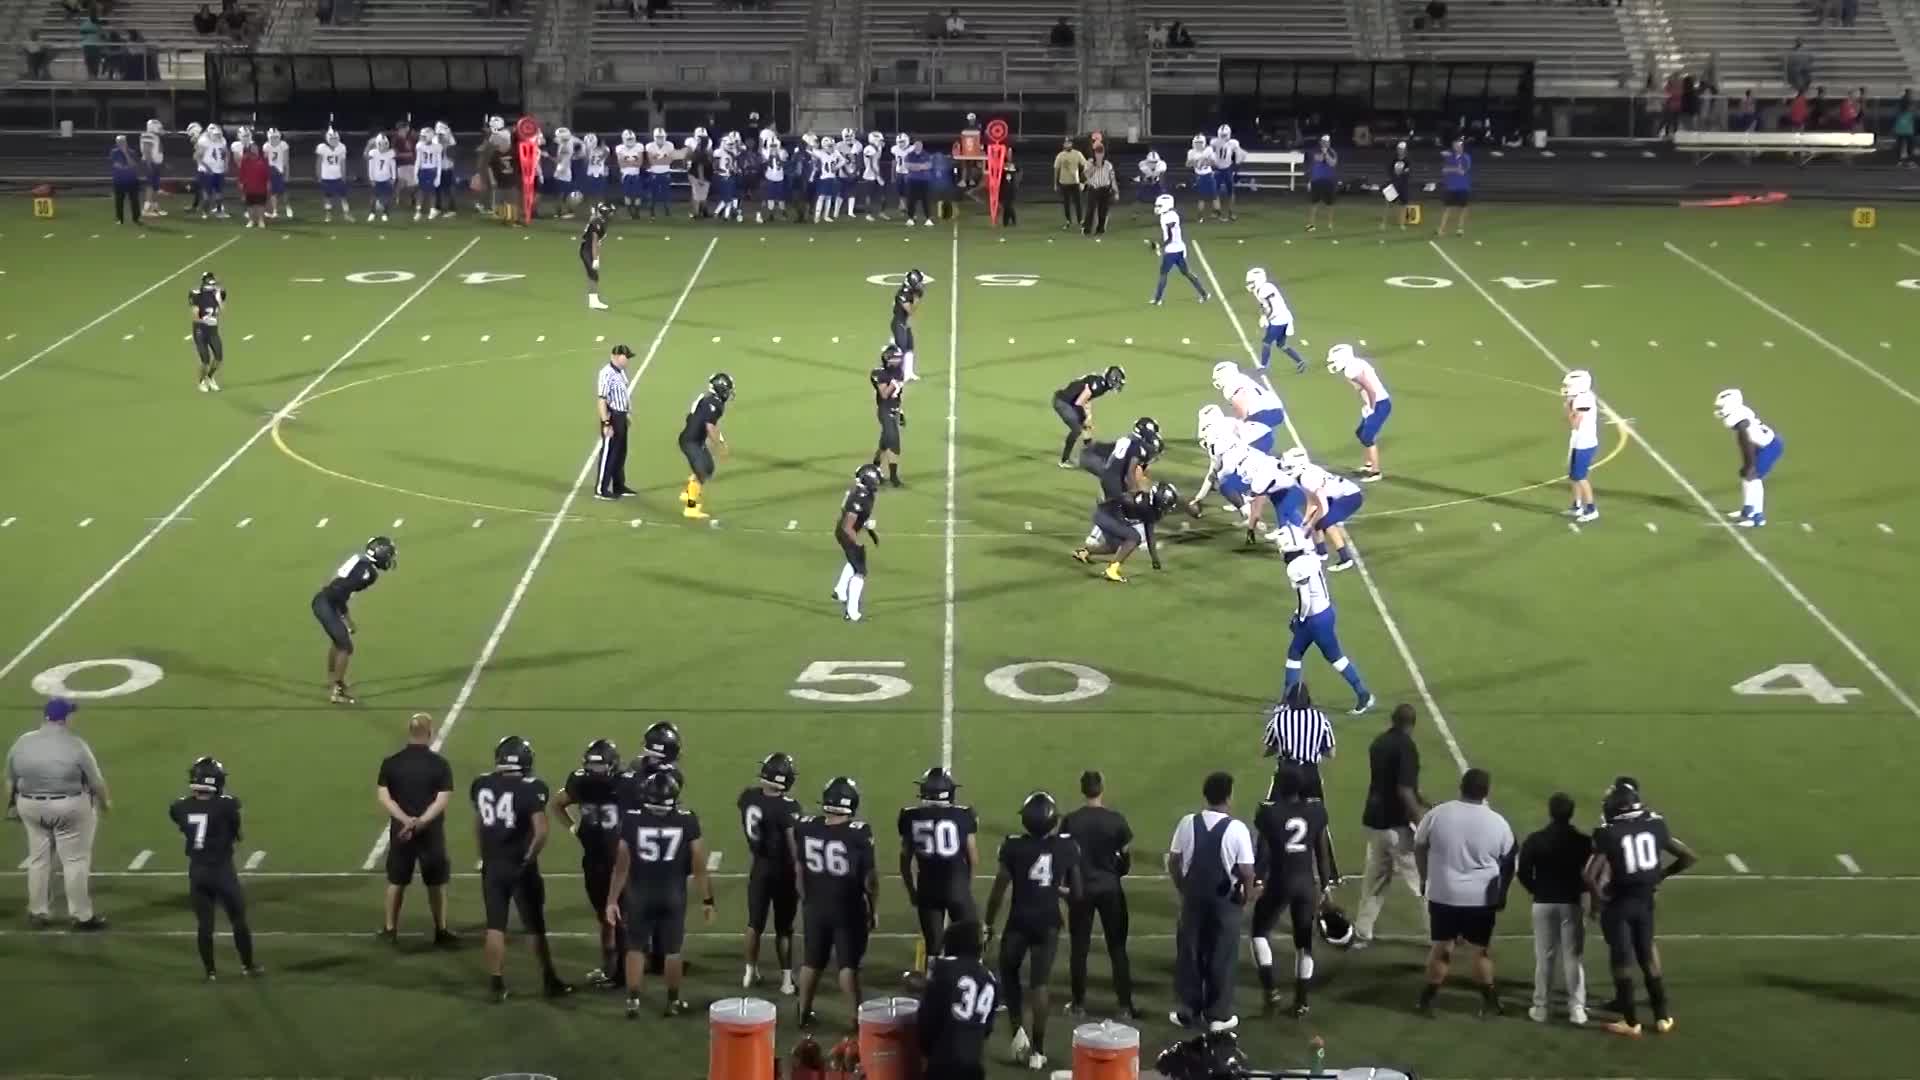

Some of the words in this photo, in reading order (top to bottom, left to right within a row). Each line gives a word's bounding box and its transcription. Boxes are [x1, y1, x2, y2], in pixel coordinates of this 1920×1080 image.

[477, 788, 516, 829] 64
[187, 813, 208, 849] 7
[638, 827, 683, 861] 57
[911, 819, 959, 857] 50
[1285, 817, 1308, 852] 2
[804, 835, 847, 875] 56
[1030, 853, 1052, 887] 4
[1622, 832, 1659, 873] 10
[951, 974, 997, 1024] 34
